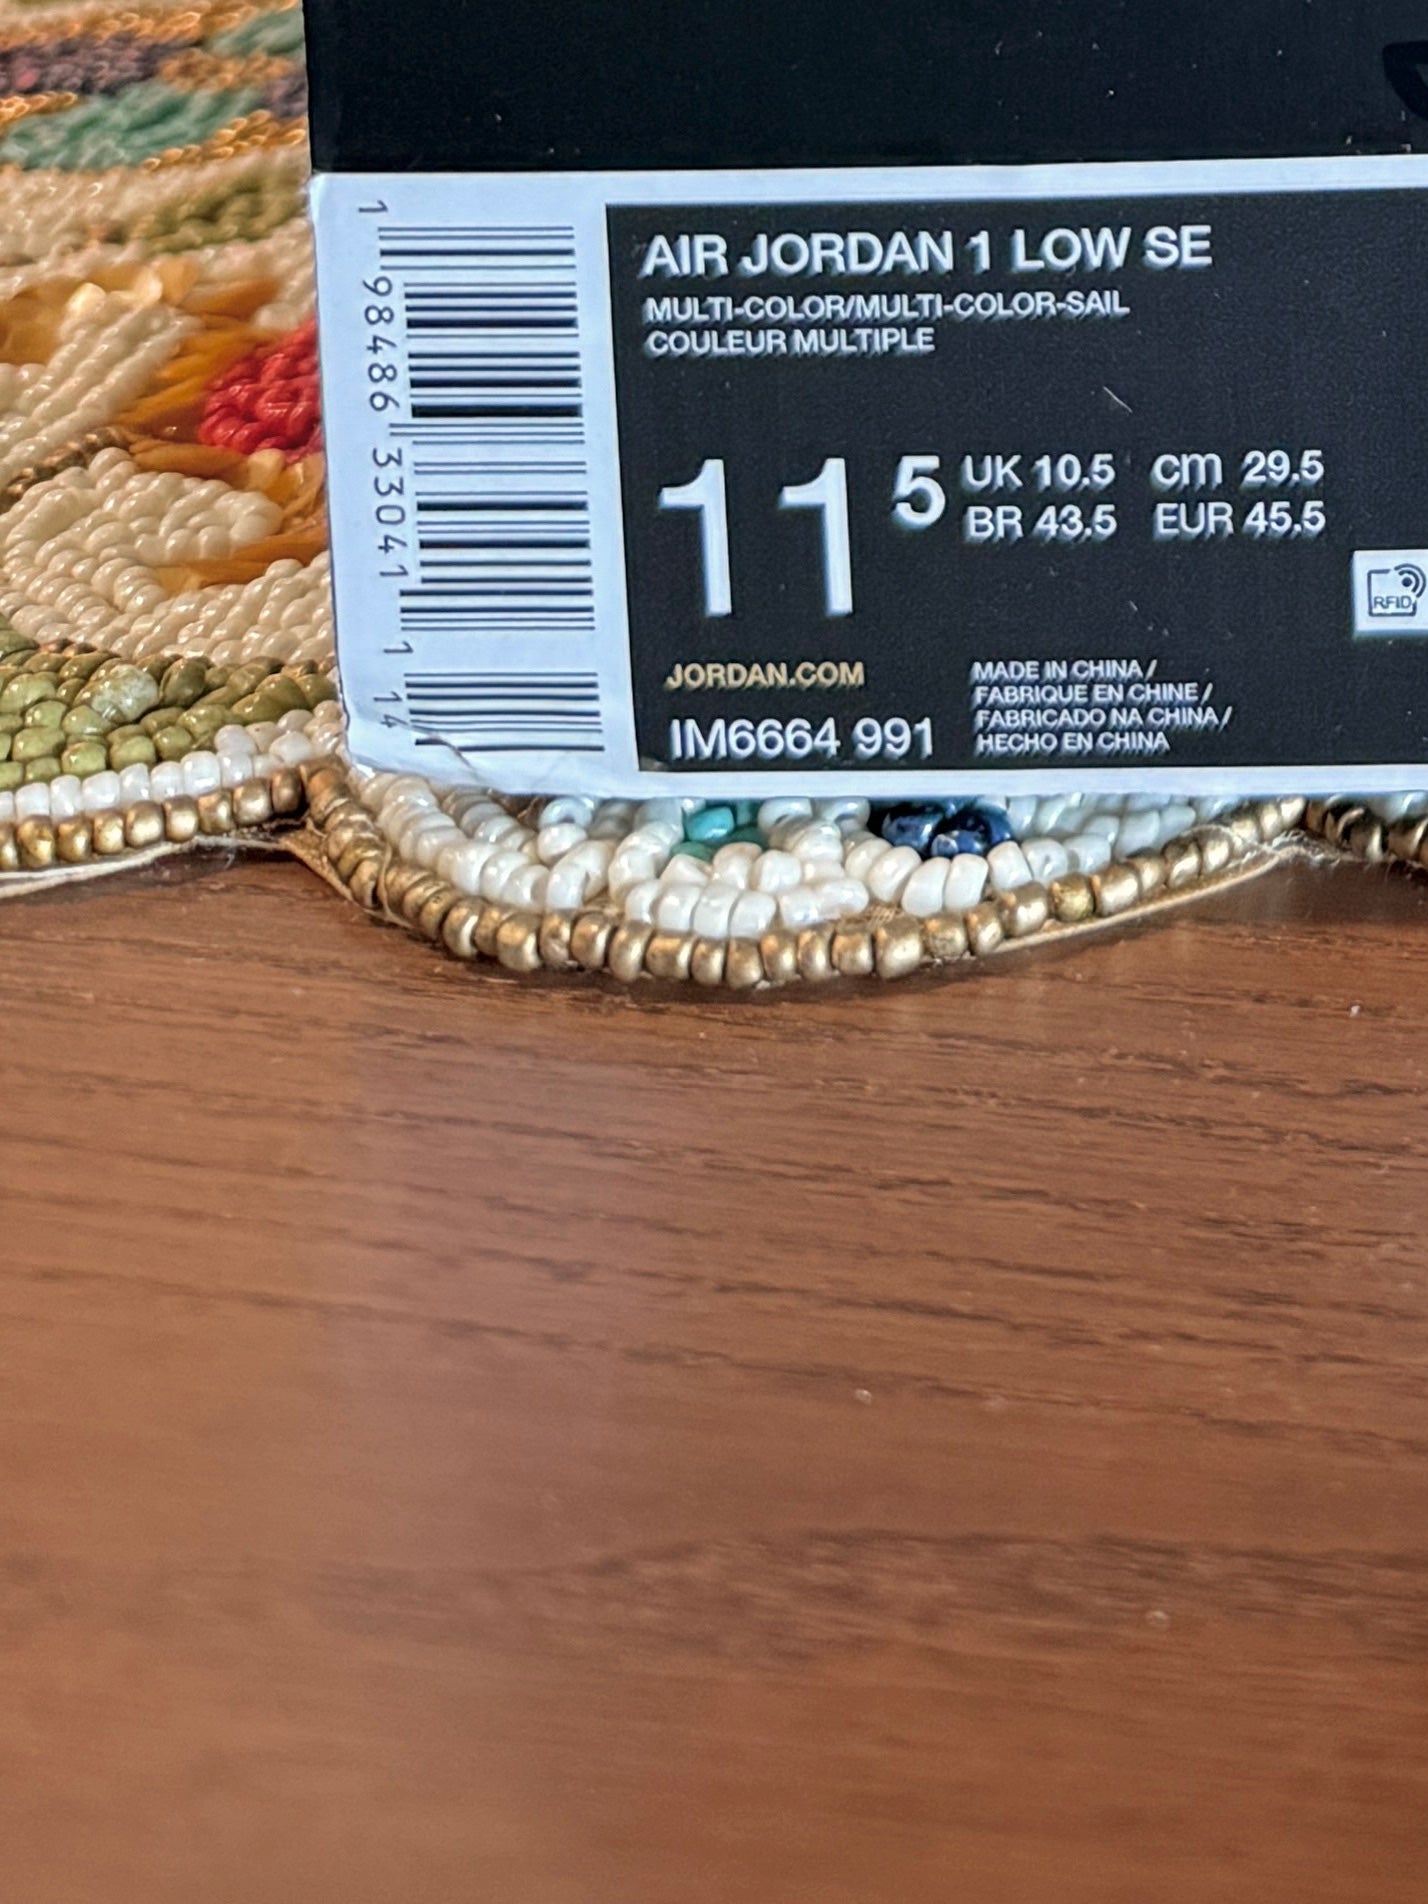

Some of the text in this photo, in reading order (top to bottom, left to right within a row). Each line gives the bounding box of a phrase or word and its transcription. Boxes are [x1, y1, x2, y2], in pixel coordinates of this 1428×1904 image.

[640, 224, 1213, 276] AIR JORDAN 1 LOW SE
[644, 290, 1130, 323] MULTI-COLOR/MULTI-COLOR-SAIL
[361, 277, 400, 412] 98486
[645, 327, 935, 357] COULEUR MULTIPLE
[962, 450, 1324, 490] UK 10.5 cm 29.5
[894, 455, 946, 528] 5
[372, 446, 410, 579] 33041
[964, 500, 1325, 540] BR 43.5 EUR 45.5
[1373, 595, 1412, 609] RFID
[665, 662, 865, 689] JORDAN.COM
[971, 660, 1039, 681] MADE
[1045, 660, 1067, 680] IN
[372, 691, 402, 729] 14
[973, 685, 1088, 706] FABRIQUE
[1093, 684, 1124, 704] EN
[974, 708, 1107, 730] FABRICADO
[1109, 707, 1144, 728] NA
[669, 716, 933, 759] IM6664 991
[975, 731, 1171, 753] HECHO EN CHINA
